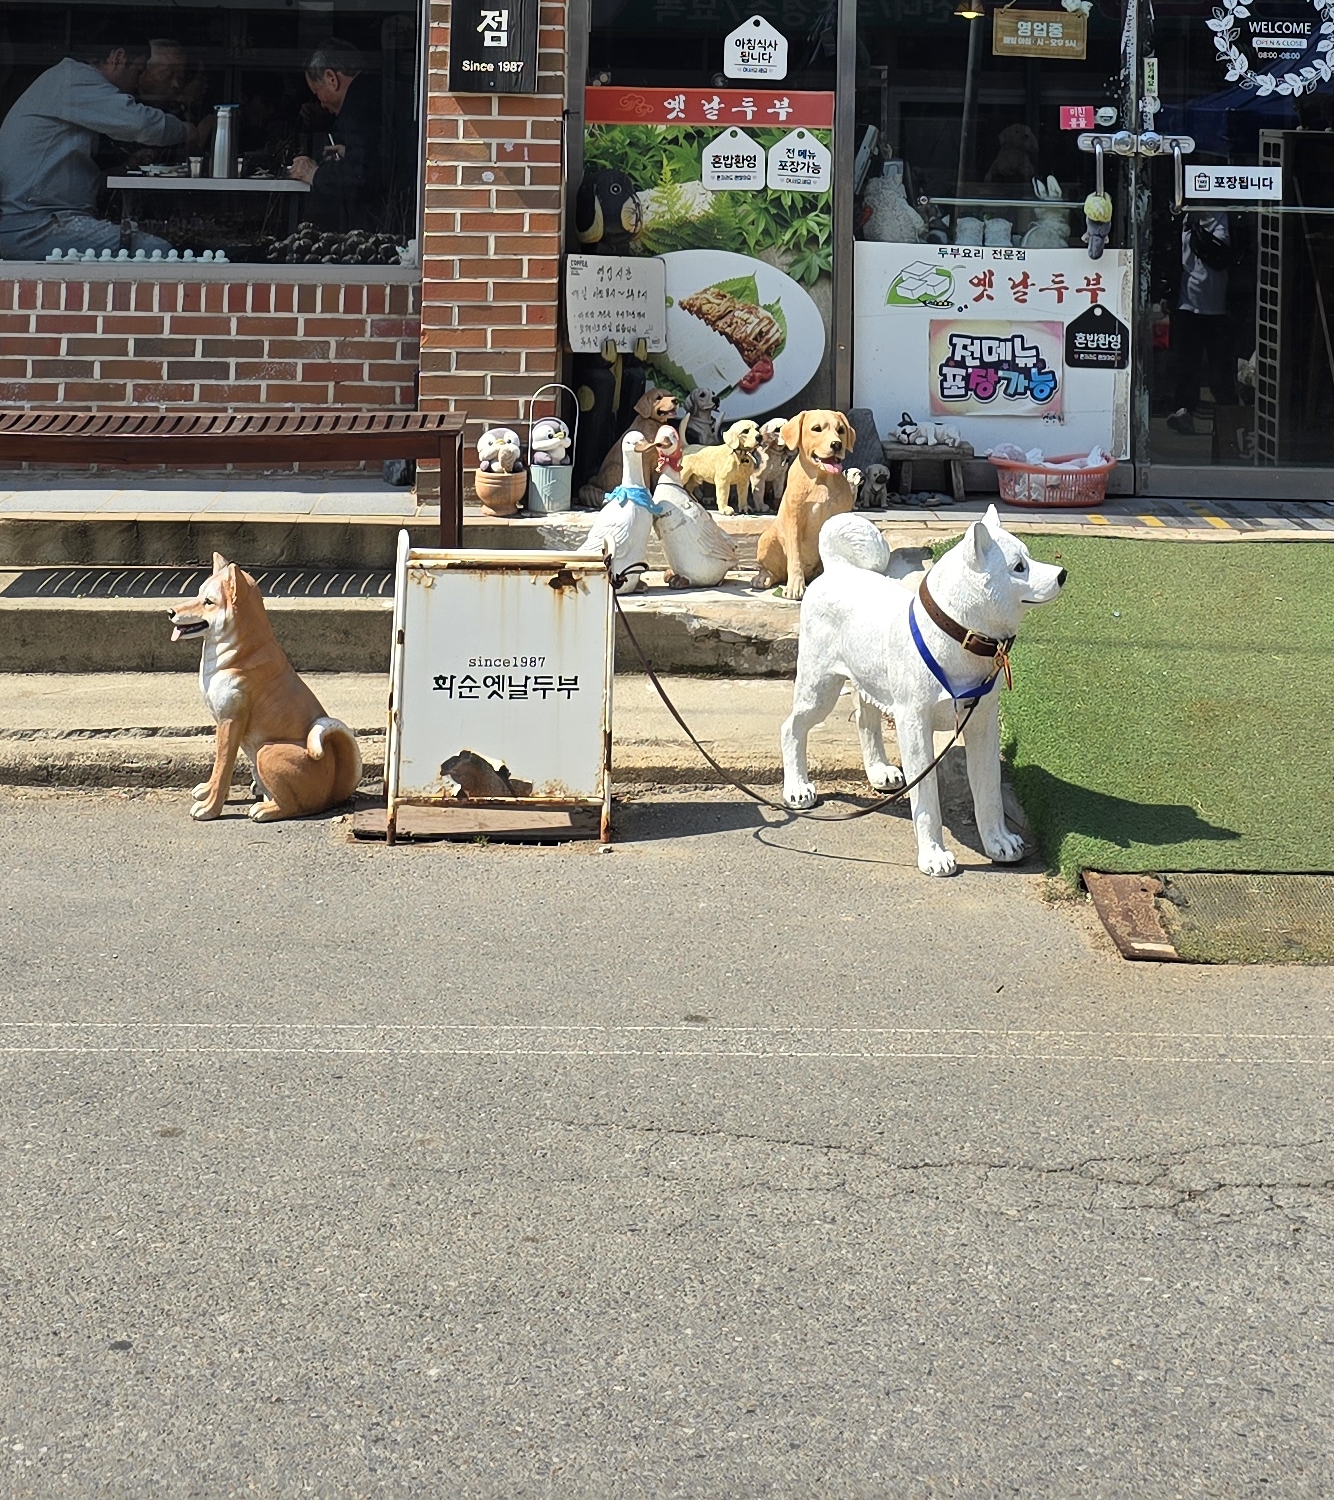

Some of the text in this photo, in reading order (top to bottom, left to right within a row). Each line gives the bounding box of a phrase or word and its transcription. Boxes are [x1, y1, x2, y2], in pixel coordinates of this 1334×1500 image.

[1018, 21, 1063, 38] 영업중
[1249, 21, 1312, 35] WELCOME
[735, 38, 778, 51] 아침식사
[1282, 39, 1304, 47] CLOSE
[740, 51, 772, 63] 됩니다
[462, 60, 524, 72] Since 1987
[663, 94, 793, 121] 옛날두부
[711, 154, 757, 168] 혼밥환영
[786, 148, 816, 160] 전 메뉴
[778, 161, 821, 175] 포장가능
[1214, 175, 1273, 191] 포장됩니다
[938, 247, 1026, 260] 두부요리 전문점
[969, 269, 1106, 304] 옛날두부
[1074, 333, 1121, 349] 혼밥환영
[950, 336, 1039, 367] 전메뉴
[941, 367, 1056, 400] 포장가능
[432, 674, 580, 700] 화순옛날두부
